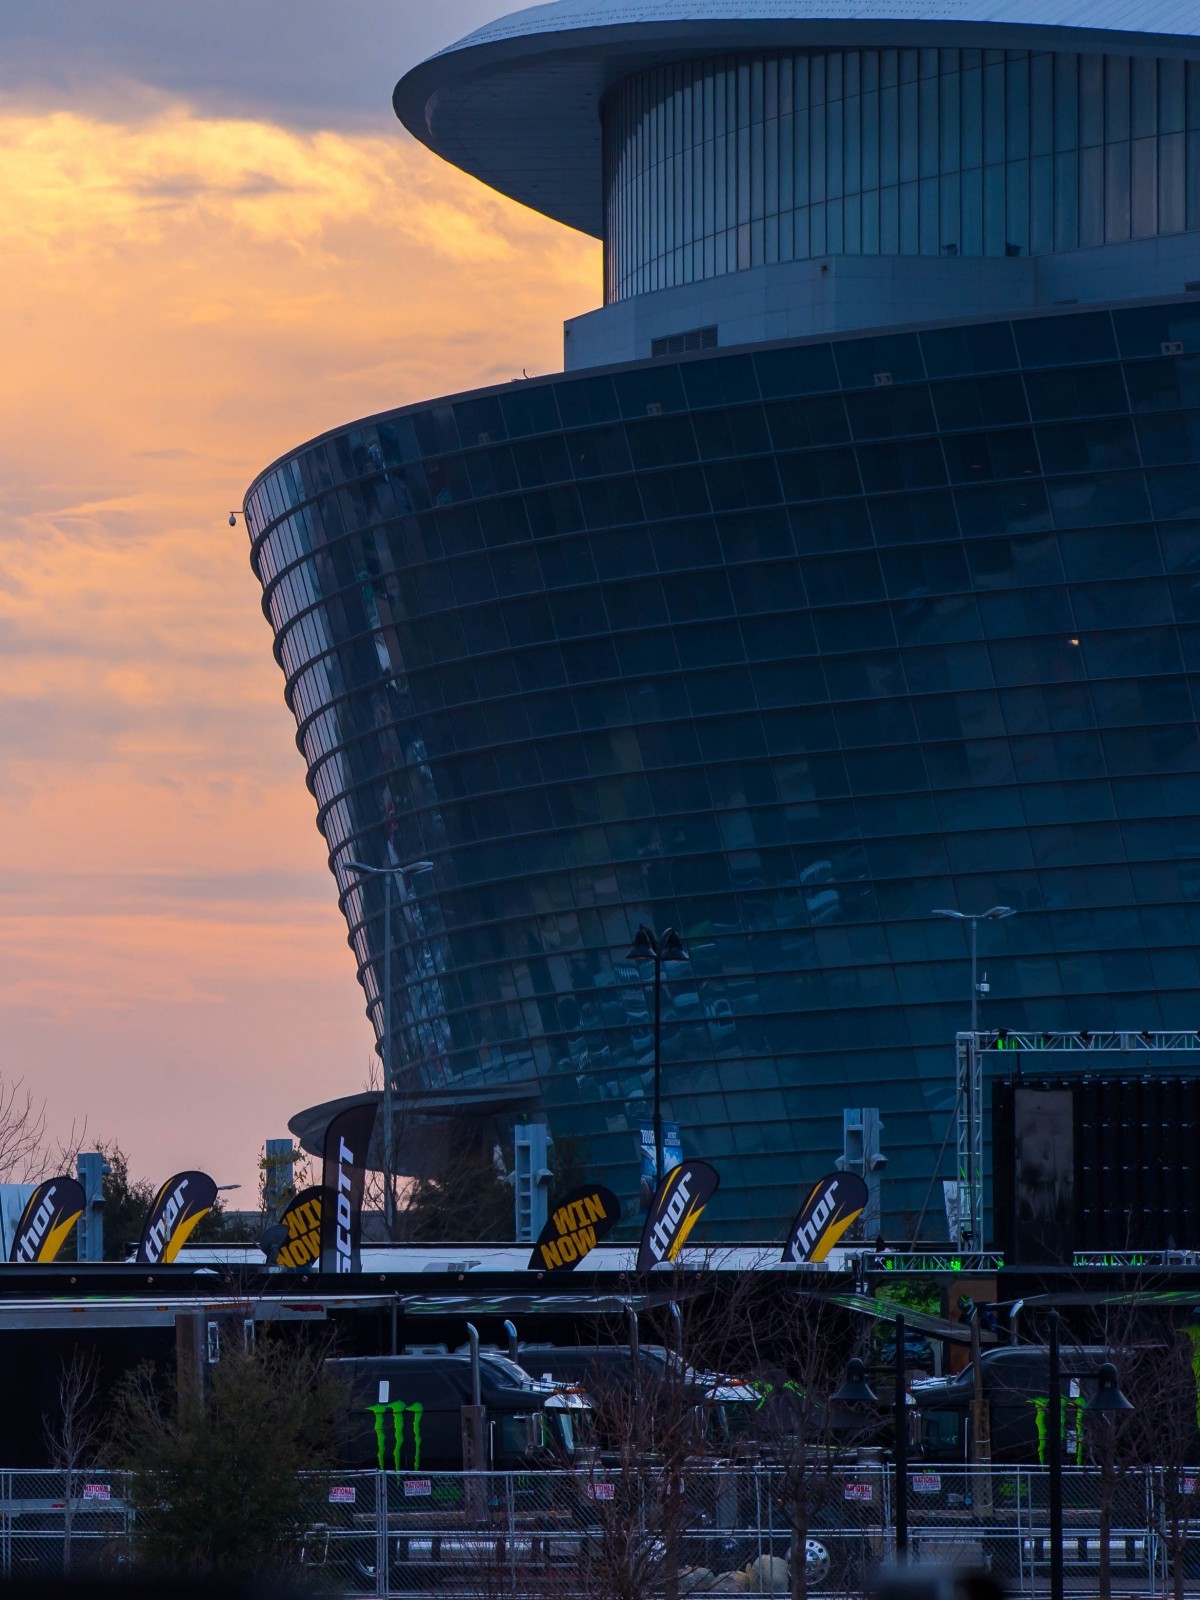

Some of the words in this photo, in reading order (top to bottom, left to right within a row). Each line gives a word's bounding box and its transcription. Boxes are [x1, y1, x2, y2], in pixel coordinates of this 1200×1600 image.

[16, 1185, 57, 1263] thor
[146, 1179, 189, 1263] thor
[336, 1135, 354, 1274] SCOTT
[552, 1193, 608, 1235] WIN
[650, 1171, 692, 1262] thor
[791, 1180, 839, 1263] thor
[539, 1224, 599, 1271] NOW
[330, 1487, 355, 1495] NATIONAL
[405, 1480, 430, 1489] NATIONAL
[912, 1475, 940, 1484] NATIONAL
